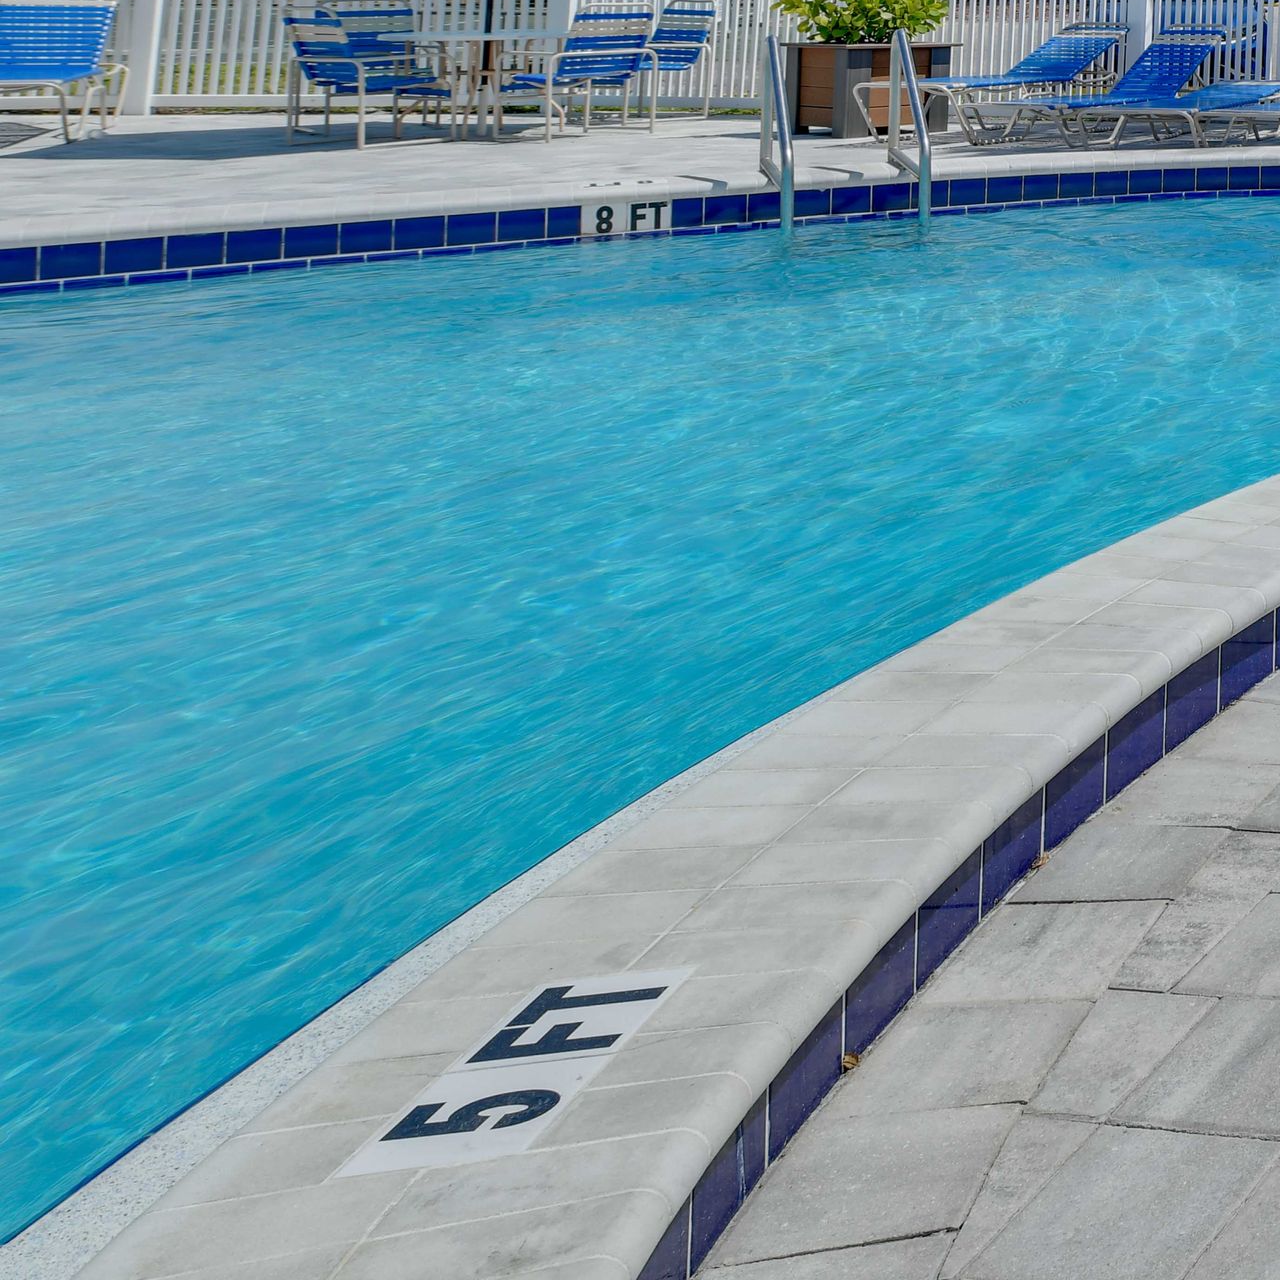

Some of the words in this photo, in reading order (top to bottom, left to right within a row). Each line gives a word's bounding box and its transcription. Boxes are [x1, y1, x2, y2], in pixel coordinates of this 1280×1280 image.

[596, 206, 613, 233] 8
[631, 202, 667, 231] FT
[466, 986, 669, 1064] FT
[379, 1089, 561, 1142] 5
